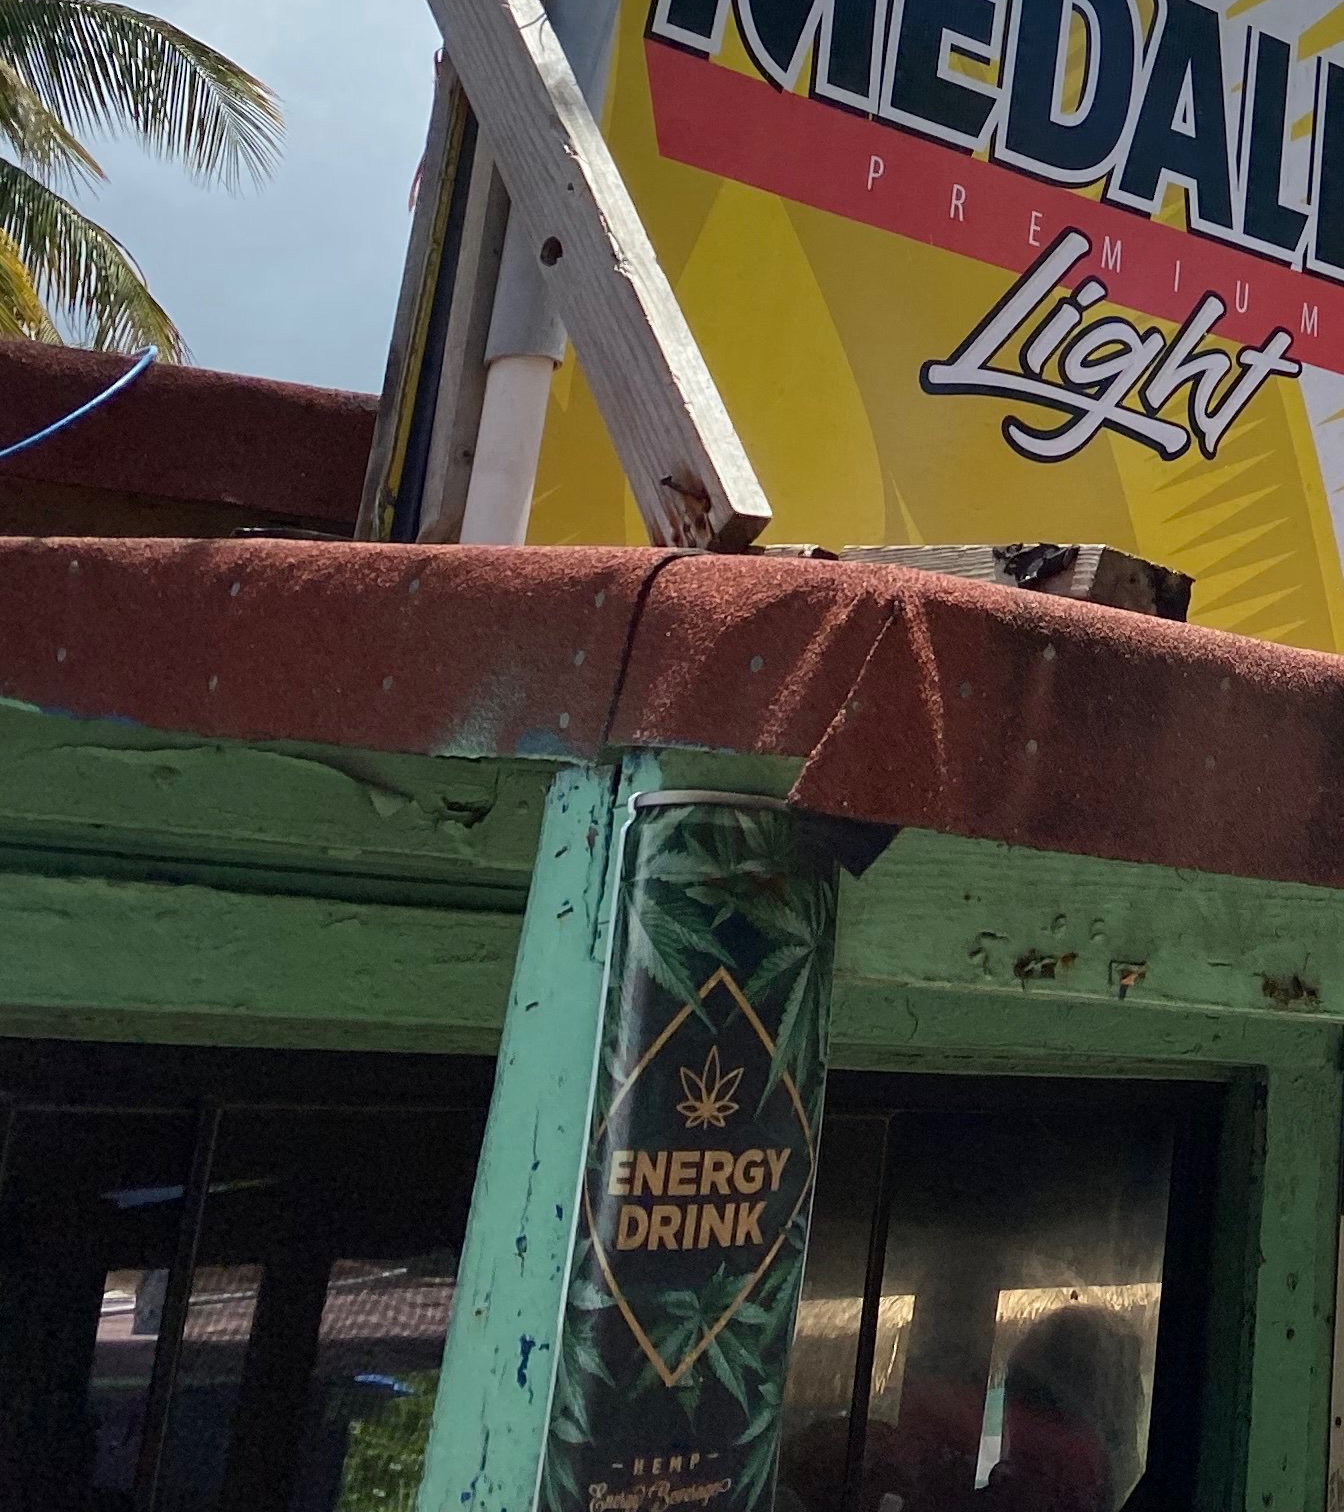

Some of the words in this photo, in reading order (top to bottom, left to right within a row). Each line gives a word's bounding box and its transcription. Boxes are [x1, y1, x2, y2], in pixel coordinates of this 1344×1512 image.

[866, 154, 1319, 338] PREMIUM
[920, 227, 1301, 463] Light
[607, 1147, 791, 1197] ENERGY
[616, 1200, 767, 1252] DRINK
[633, 1452, 700, 1475] HEMP
